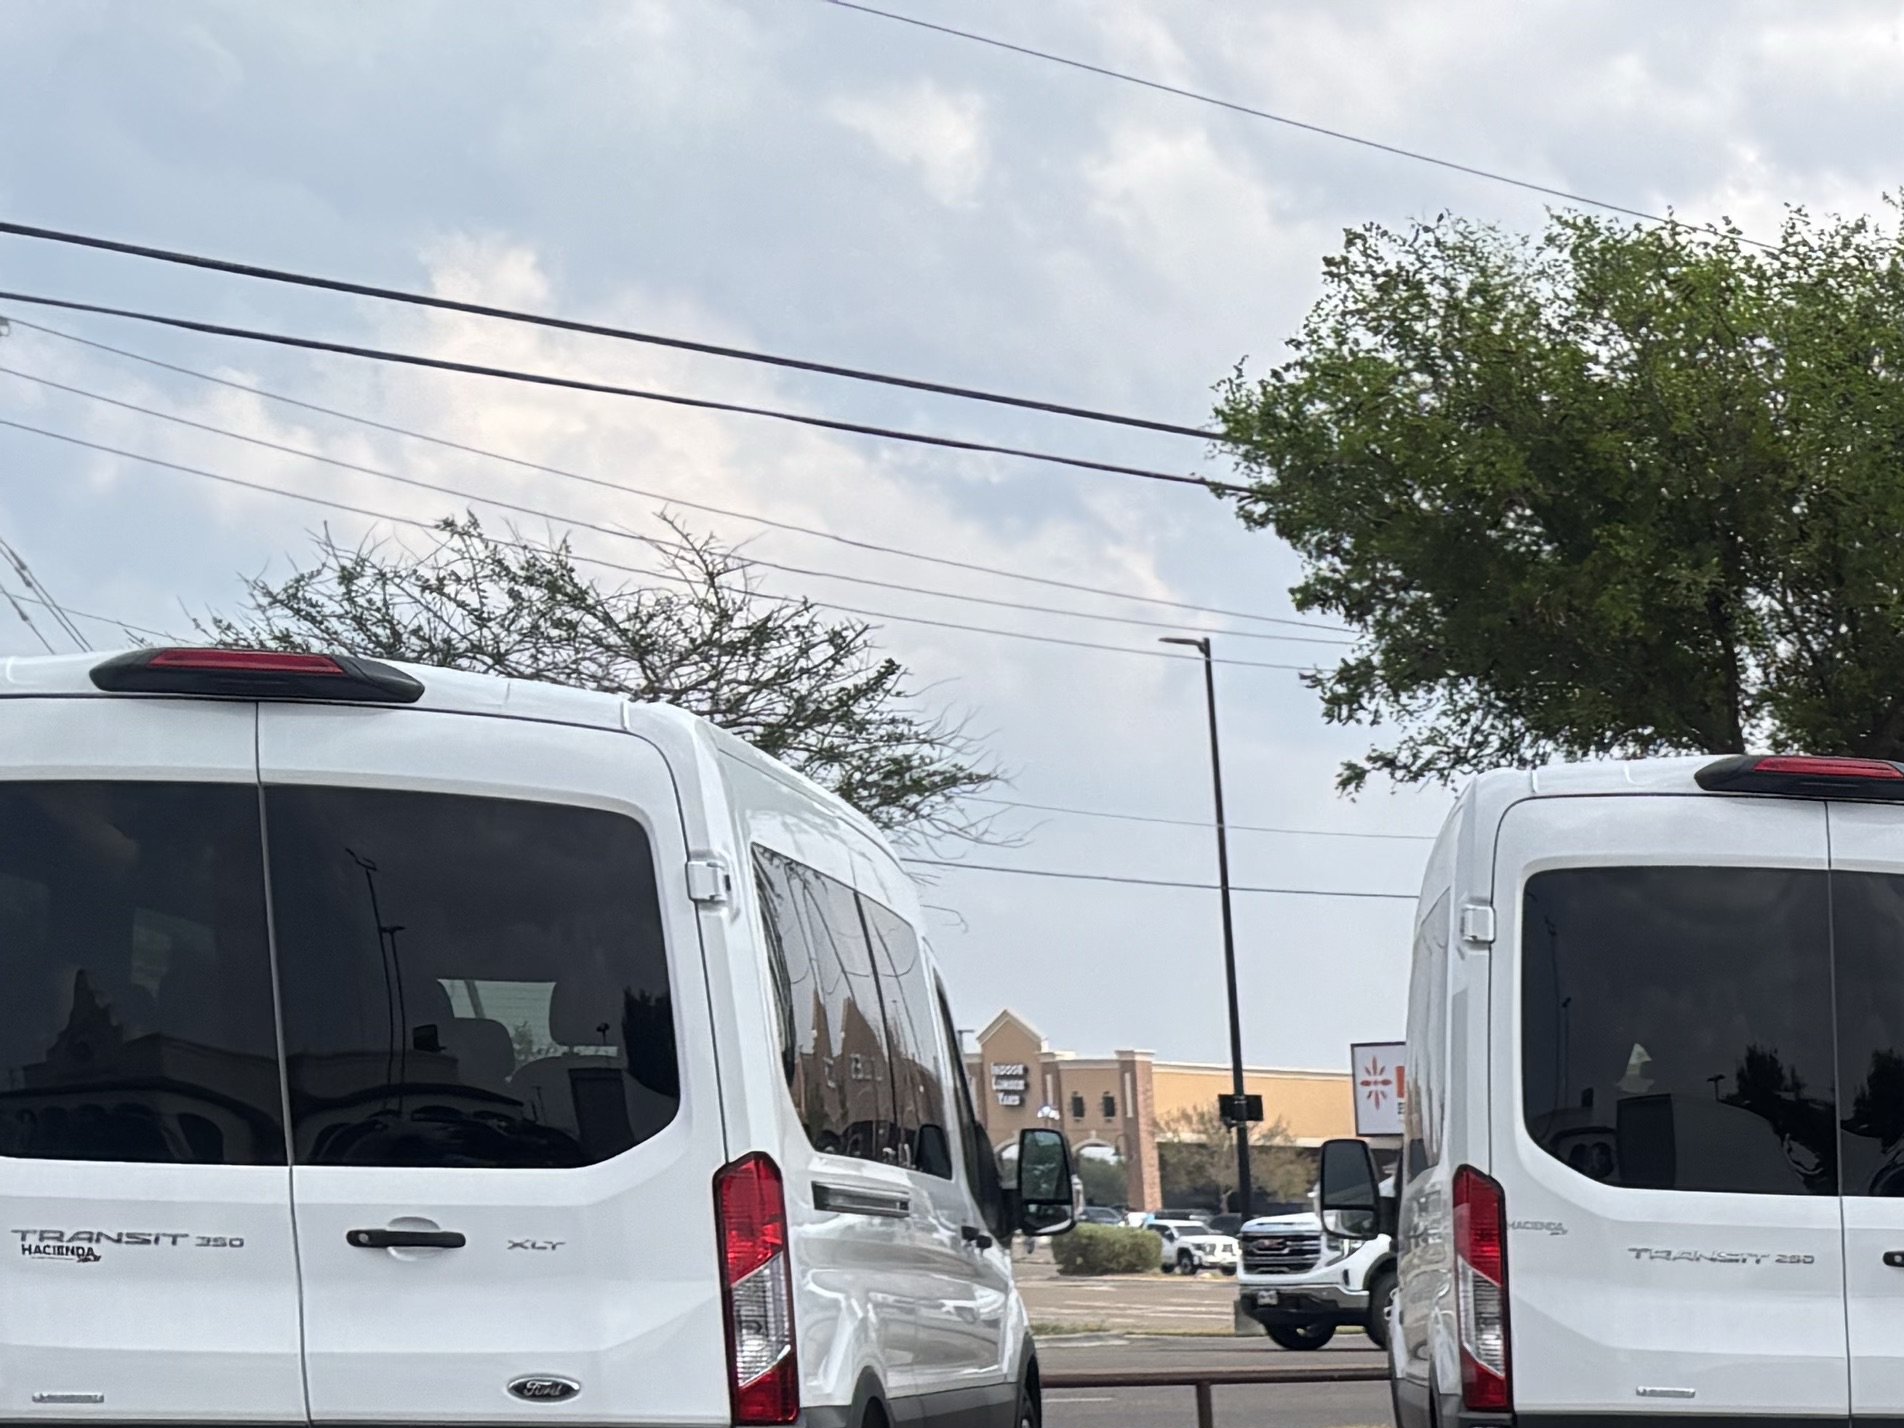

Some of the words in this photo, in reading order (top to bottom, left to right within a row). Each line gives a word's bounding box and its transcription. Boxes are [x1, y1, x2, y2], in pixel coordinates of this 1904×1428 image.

[11, 1229, 189, 1246] TRANSIT
[195, 1236, 245, 1247] 350
[21, 1244, 95, 1257] HACIENDA
[507, 1240, 566, 1250] XLT
